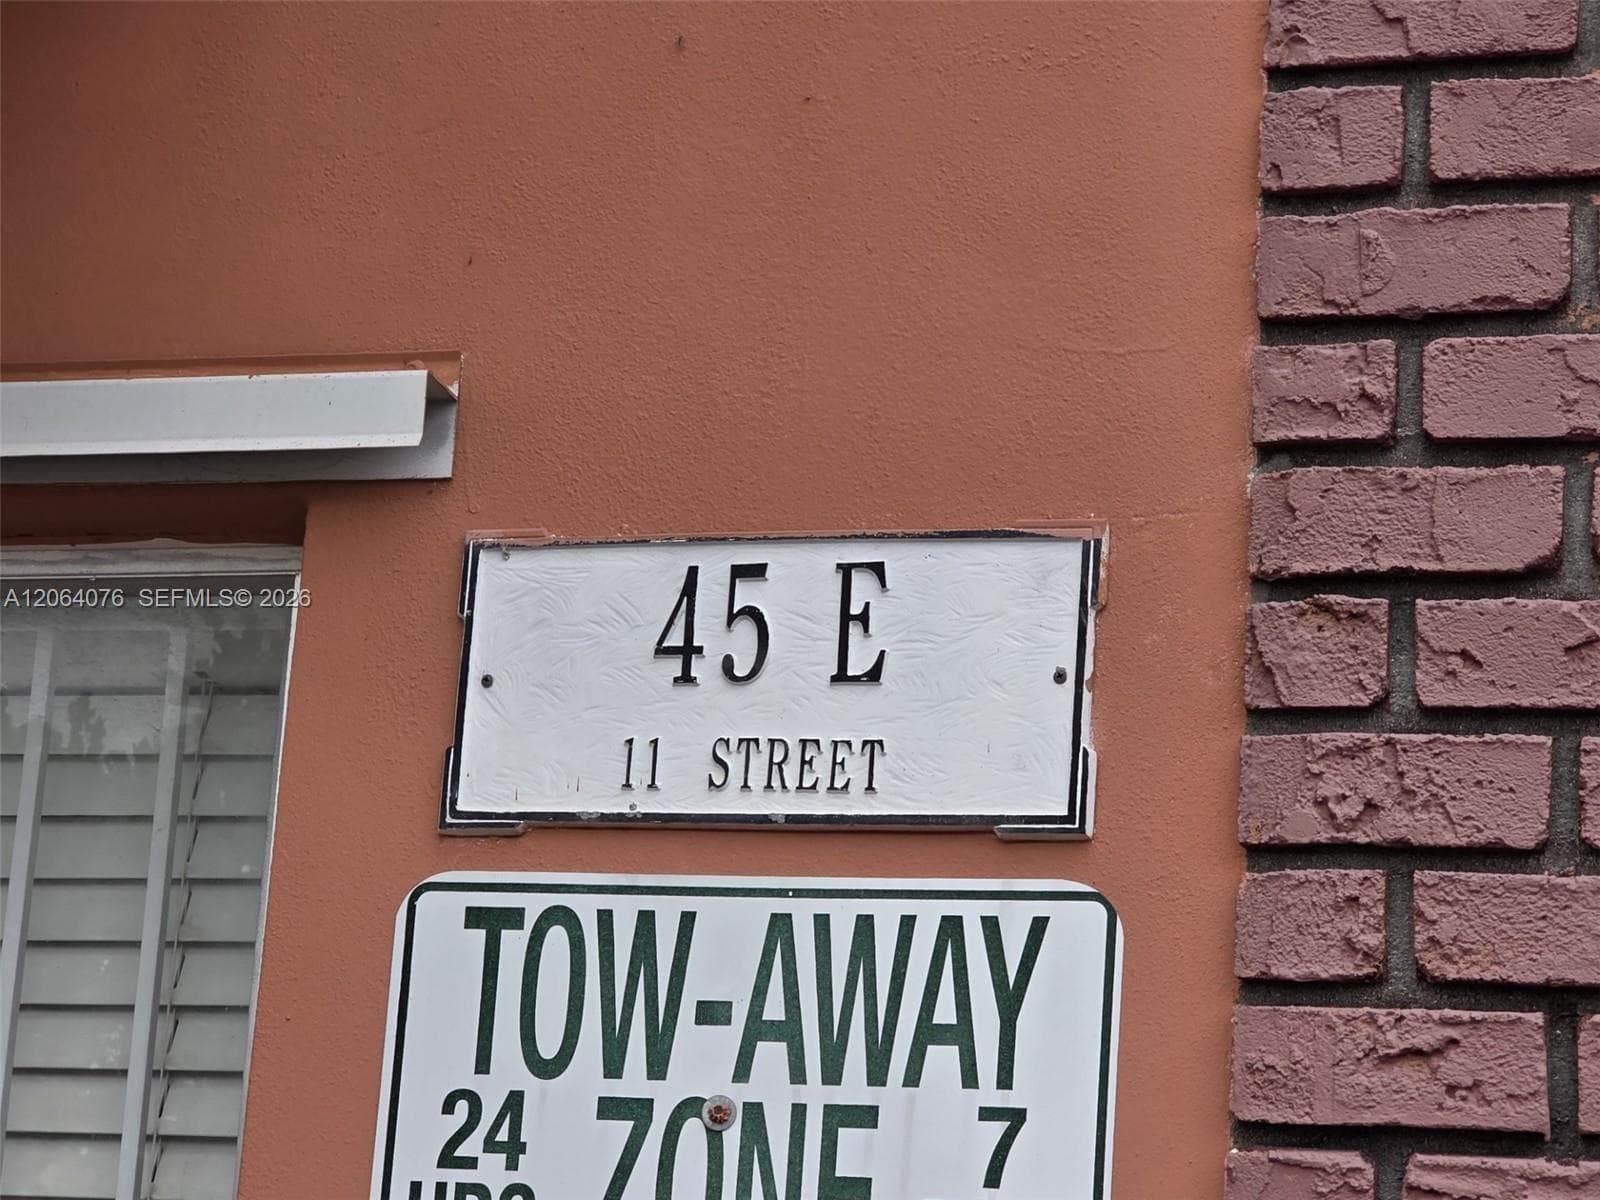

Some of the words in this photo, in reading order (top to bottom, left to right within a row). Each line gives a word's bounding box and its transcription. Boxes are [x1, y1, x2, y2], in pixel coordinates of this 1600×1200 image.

[654, 562, 768, 686] 45
[829, 560, 889, 686] E
[621, 736, 661, 790] 11
[708, 736, 886, 792] STREET
[463, 904, 1050, 1090] TOW-AWAY
[436, 1089, 527, 1171] 24
[976, 1106, 1028, 1189] 7
